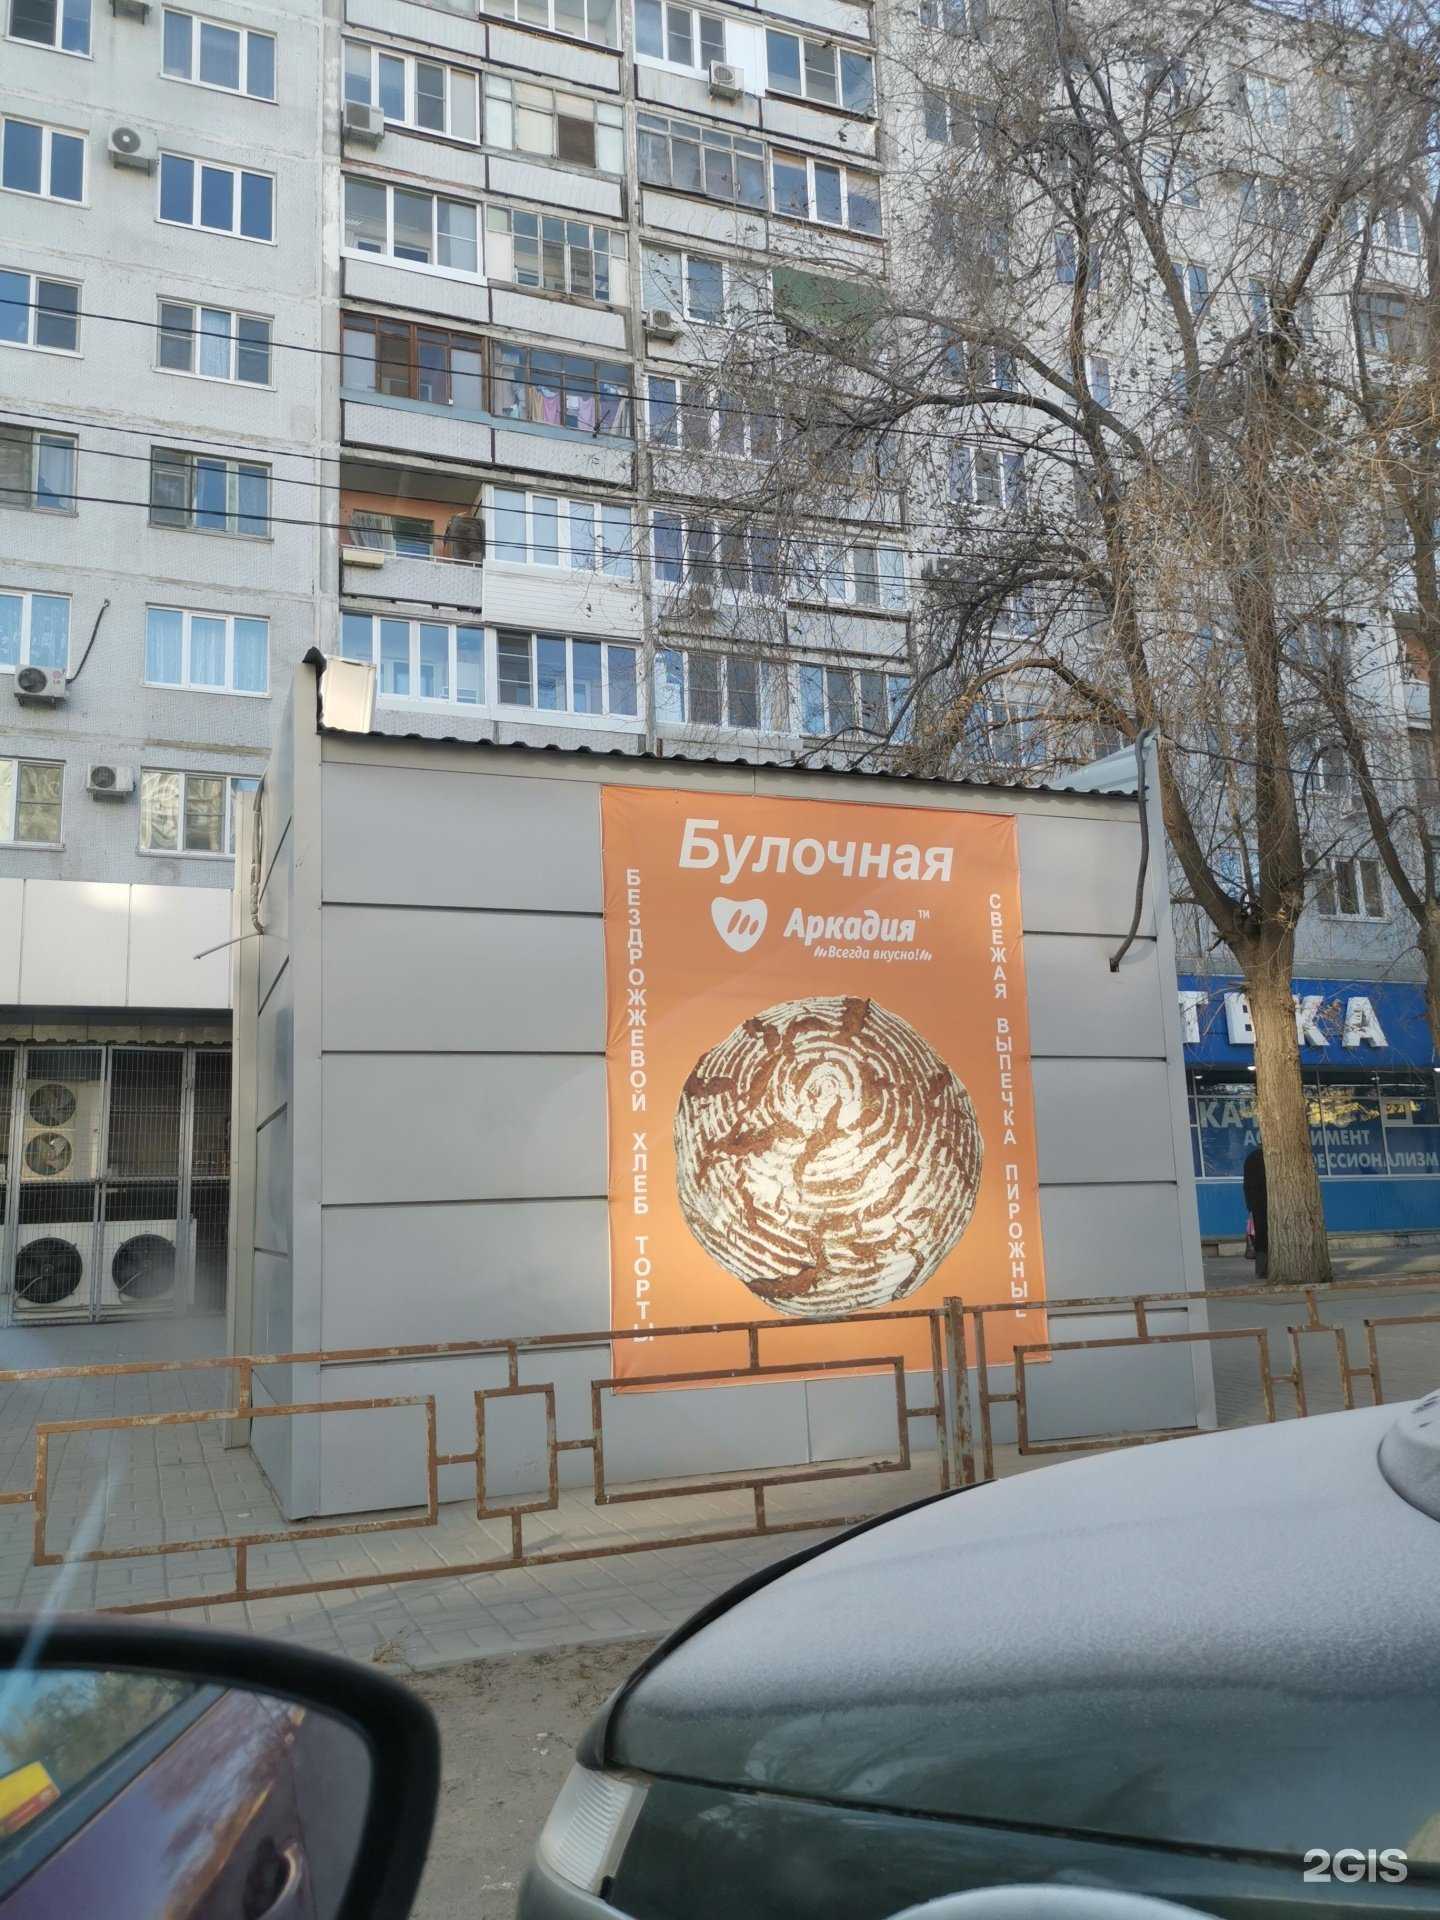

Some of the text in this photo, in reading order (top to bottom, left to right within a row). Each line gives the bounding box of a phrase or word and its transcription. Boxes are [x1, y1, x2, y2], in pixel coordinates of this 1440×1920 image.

[678, 818, 955, 884] Булочная
[783, 907, 916, 946] Аркадия
[828, 945, 919, 963] Всегда вкусно!
[989, 893, 1008, 1000] СВЕЖАЯ
[626, 868, 648, 1112] БЕЗДРОЖЖЕВОЙ
[996, 1017, 1017, 1145] ВЫПЕЧКА
[632, 1132, 649, 1215] ХЛЕБ
